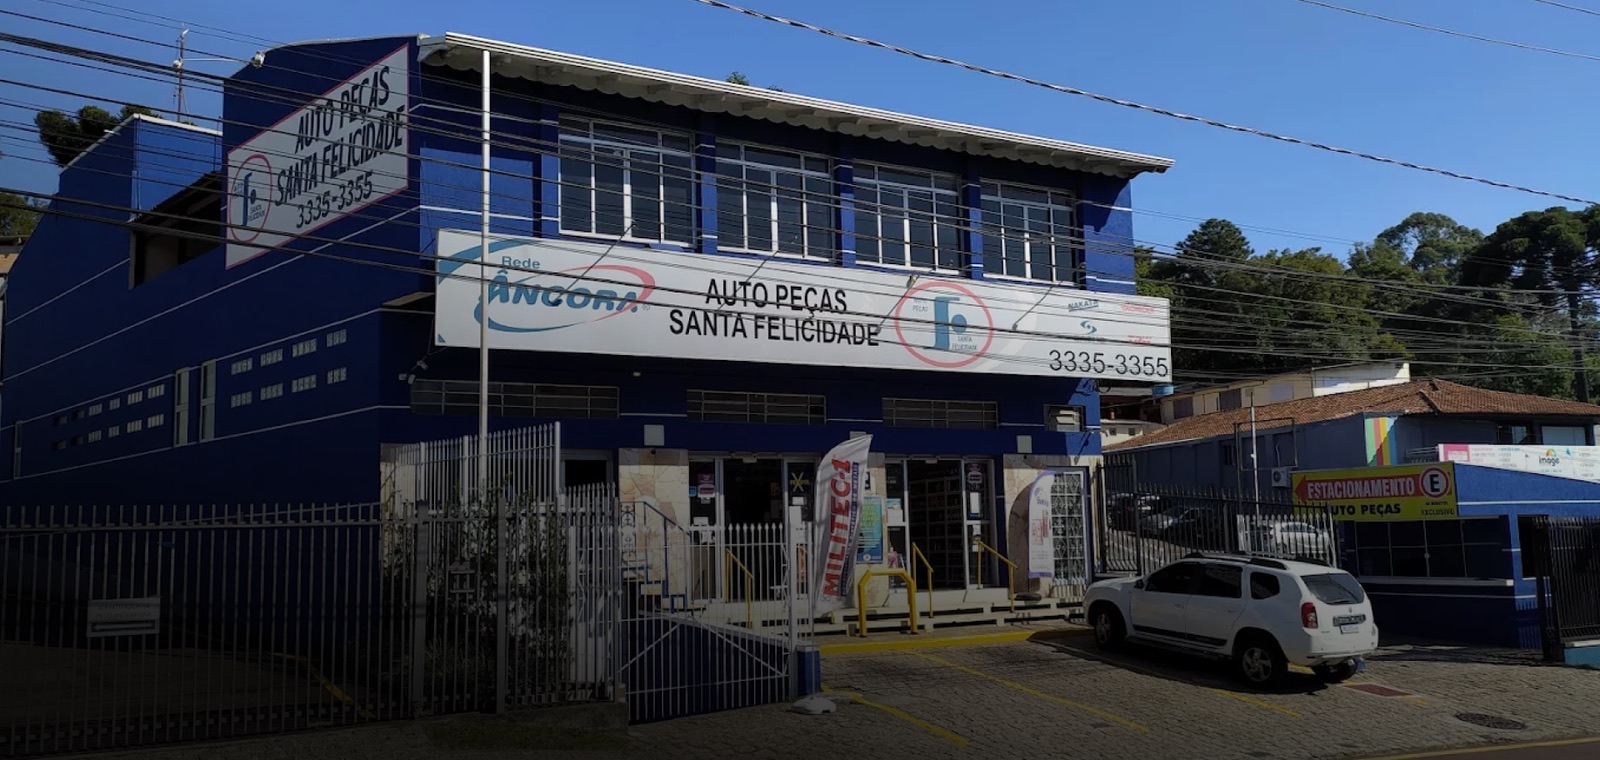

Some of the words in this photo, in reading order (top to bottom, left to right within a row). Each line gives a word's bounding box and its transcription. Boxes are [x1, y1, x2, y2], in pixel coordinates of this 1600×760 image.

[295, 99, 334, 154] AUTO
[340, 66, 390, 129] PEÇAS
[275, 151, 317, 207] SANTA
[322, 105, 404, 183] FELICIDADE
[296, 172, 373, 229] 3335-3355
[502, 256, 541, 269] Rede
[486, 269, 638, 313] ÂNCORA
[705, 278, 768, 308] AUTO
[777, 282, 847, 314] PEÇAS
[670, 309, 747, 339] SANTA
[754, 316, 880, 347] FELICIDADE
[1049, 350, 1168, 377] 3335-3355
[1307, 477, 1416, 499] ESTACIONAMENTO
[1429, 473, 1440, 493] E
[1326, 505, 1356, 515] UTO
[1361, 503, 1401, 517] PEÇAS
